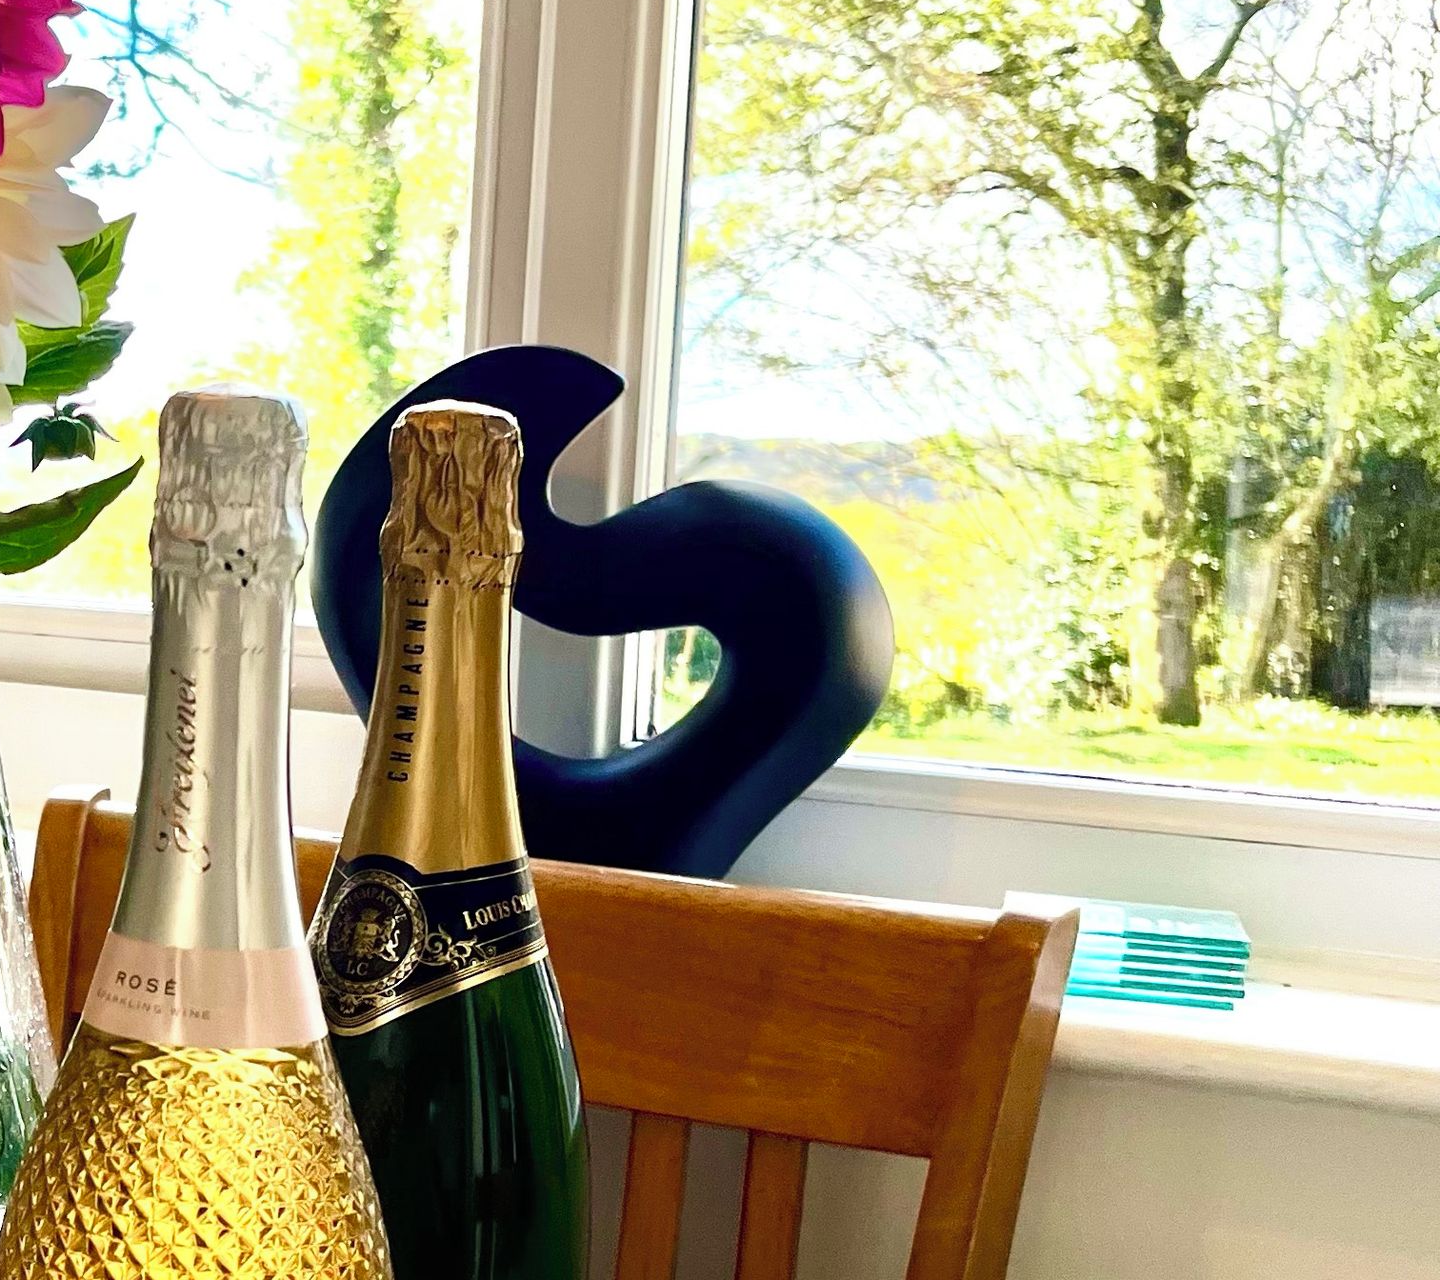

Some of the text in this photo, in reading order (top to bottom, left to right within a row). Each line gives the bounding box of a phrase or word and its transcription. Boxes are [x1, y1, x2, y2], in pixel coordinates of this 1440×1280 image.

[387, 598, 429, 783] CHAMPAGNE
[462, 900, 511, 931] LOUIS
[345, 959, 370, 976] LC
[114, 970, 177, 996] ROSÉ
